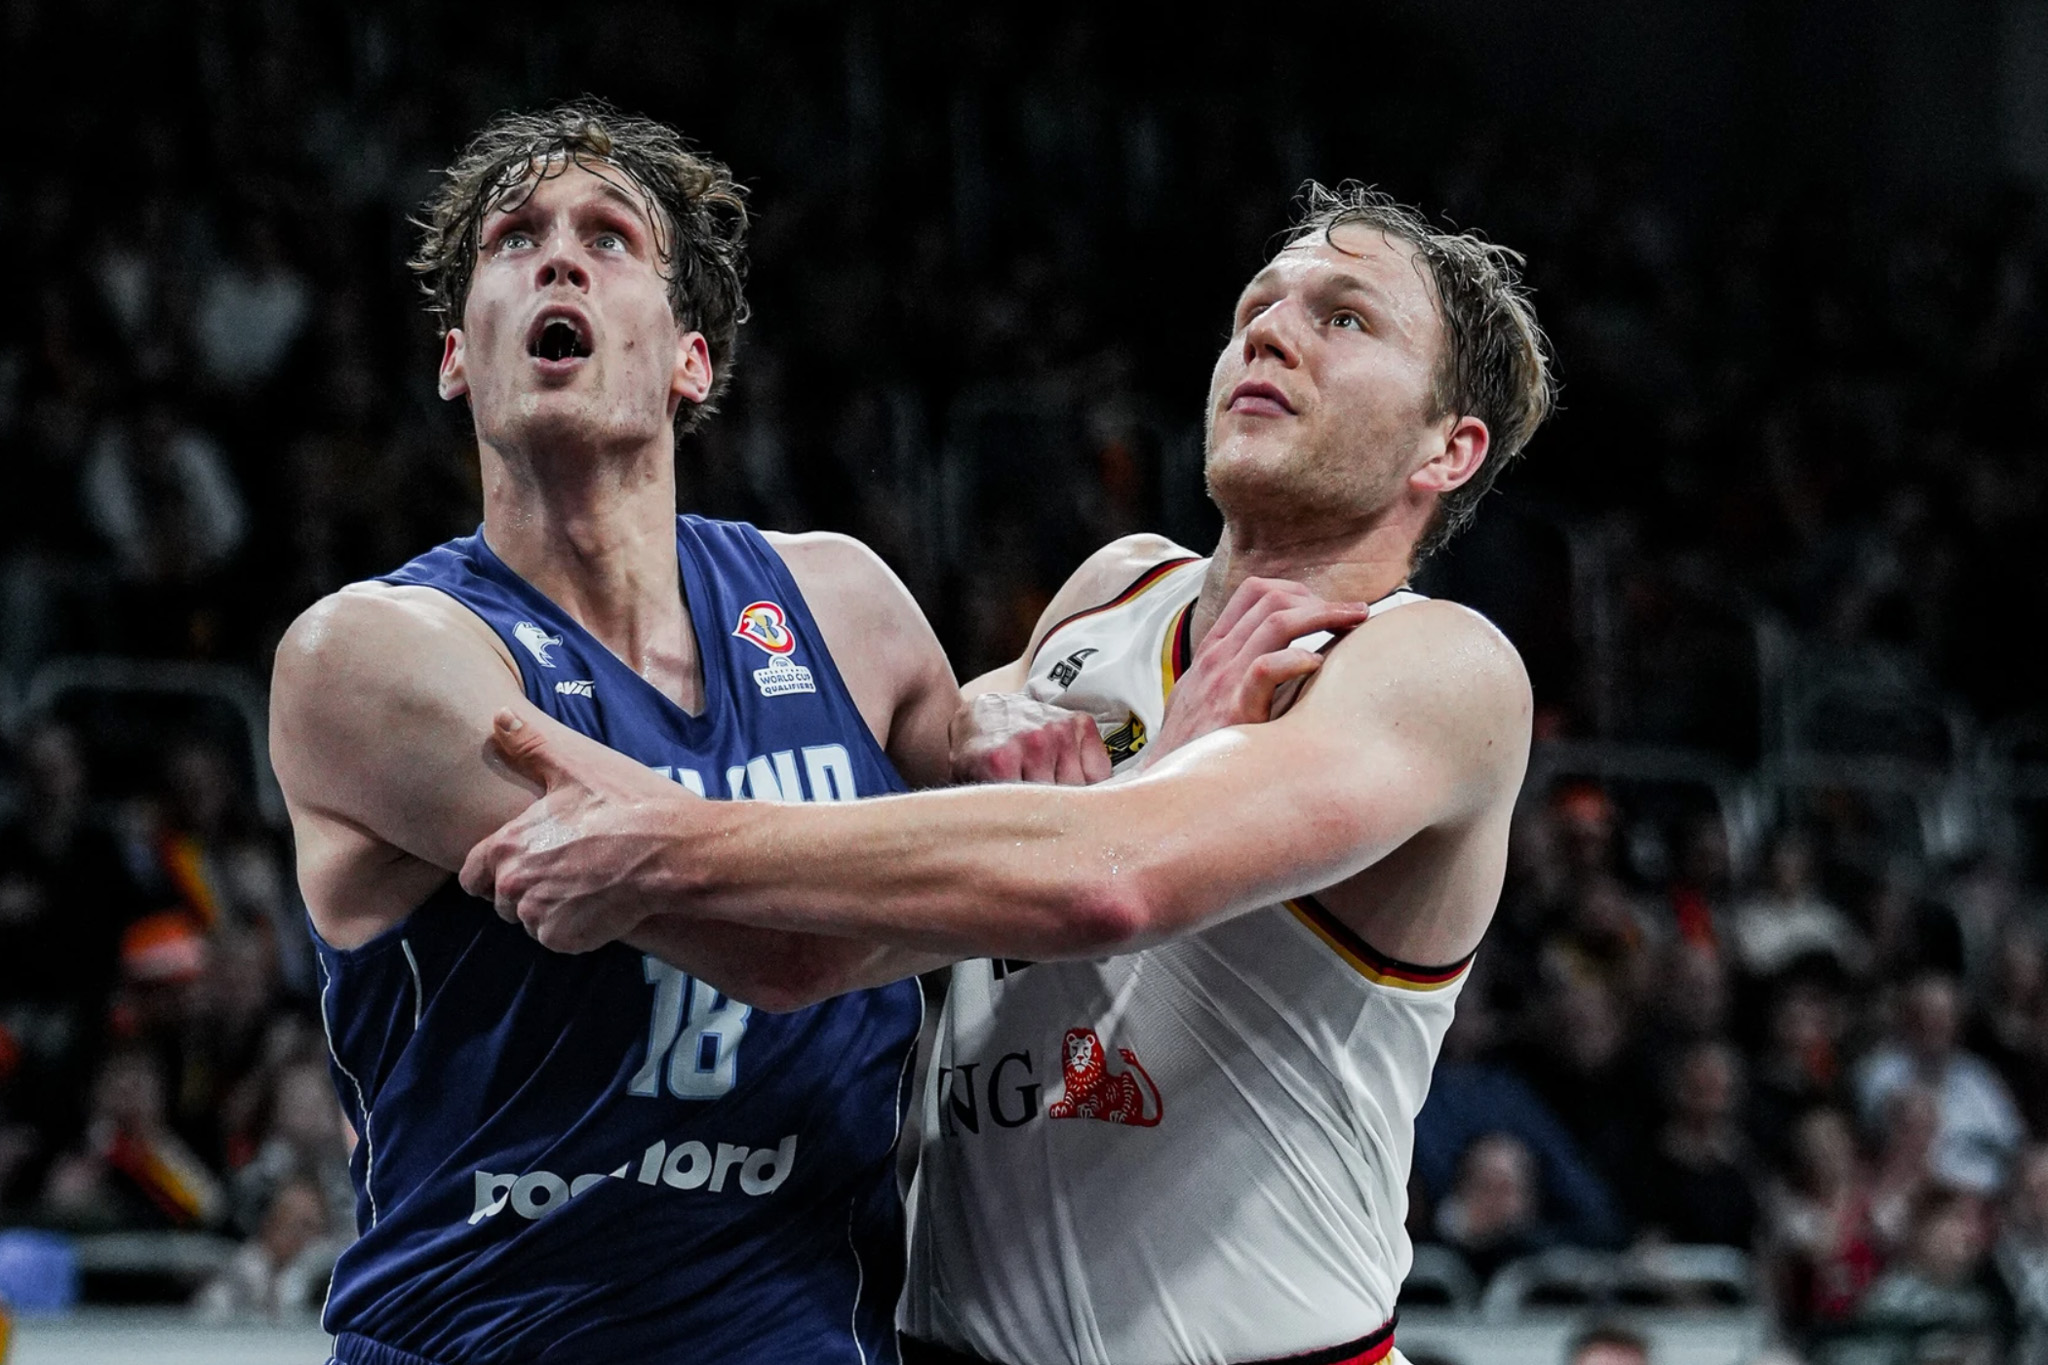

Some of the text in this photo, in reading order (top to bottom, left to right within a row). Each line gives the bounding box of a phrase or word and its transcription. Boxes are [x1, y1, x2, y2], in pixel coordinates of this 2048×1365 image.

[760, 673, 795, 685] WORLD
[764, 682, 815, 695] QUALIFIERS
[626, 954, 752, 1101] 18
